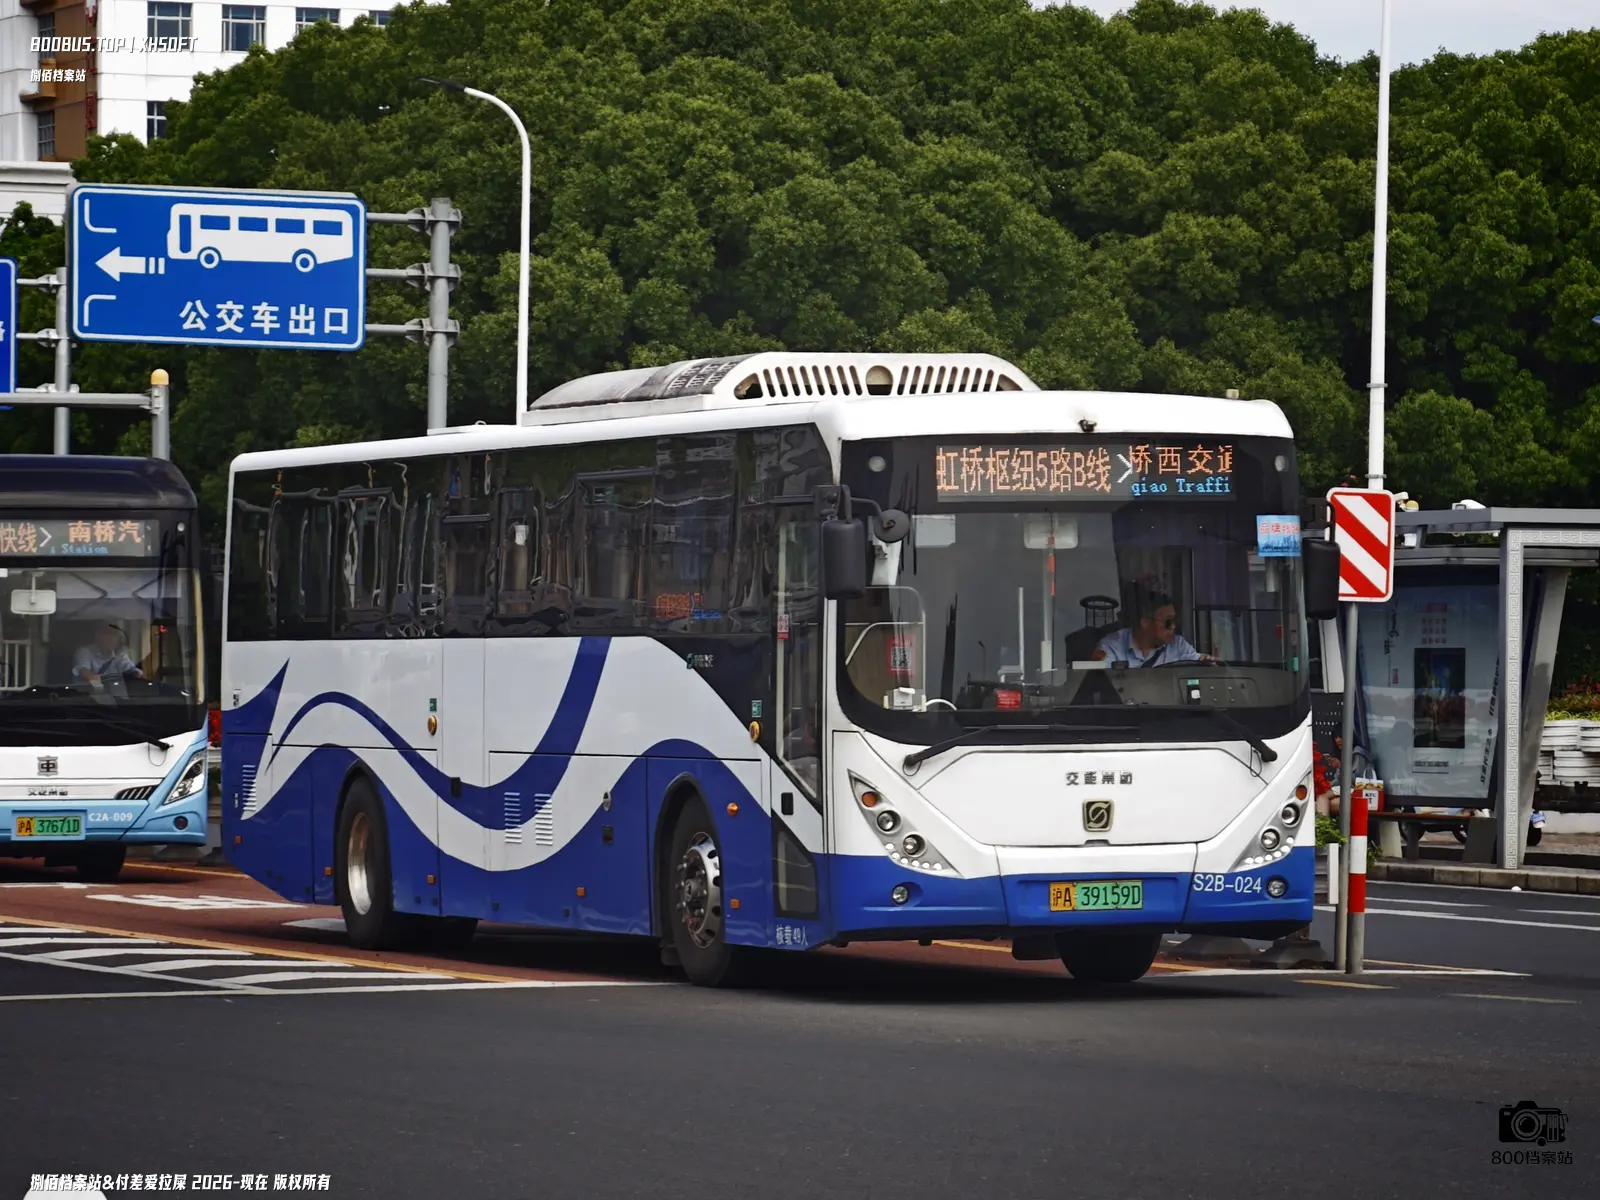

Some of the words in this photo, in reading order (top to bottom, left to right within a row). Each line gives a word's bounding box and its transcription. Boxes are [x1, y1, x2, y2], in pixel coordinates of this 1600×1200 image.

[179, 299, 349, 336] 公交车出口
[936, 446, 1112, 493] 虹桥枢纽5路B线
[1175, 476, 1231, 493] Traffi
[0, 522, 37, 553] 快线
[88, 812, 133, 822] C2A-009
[1193, 873, 1263, 894] S2B-024
[1081, 884, 1142, 906] 39159D
